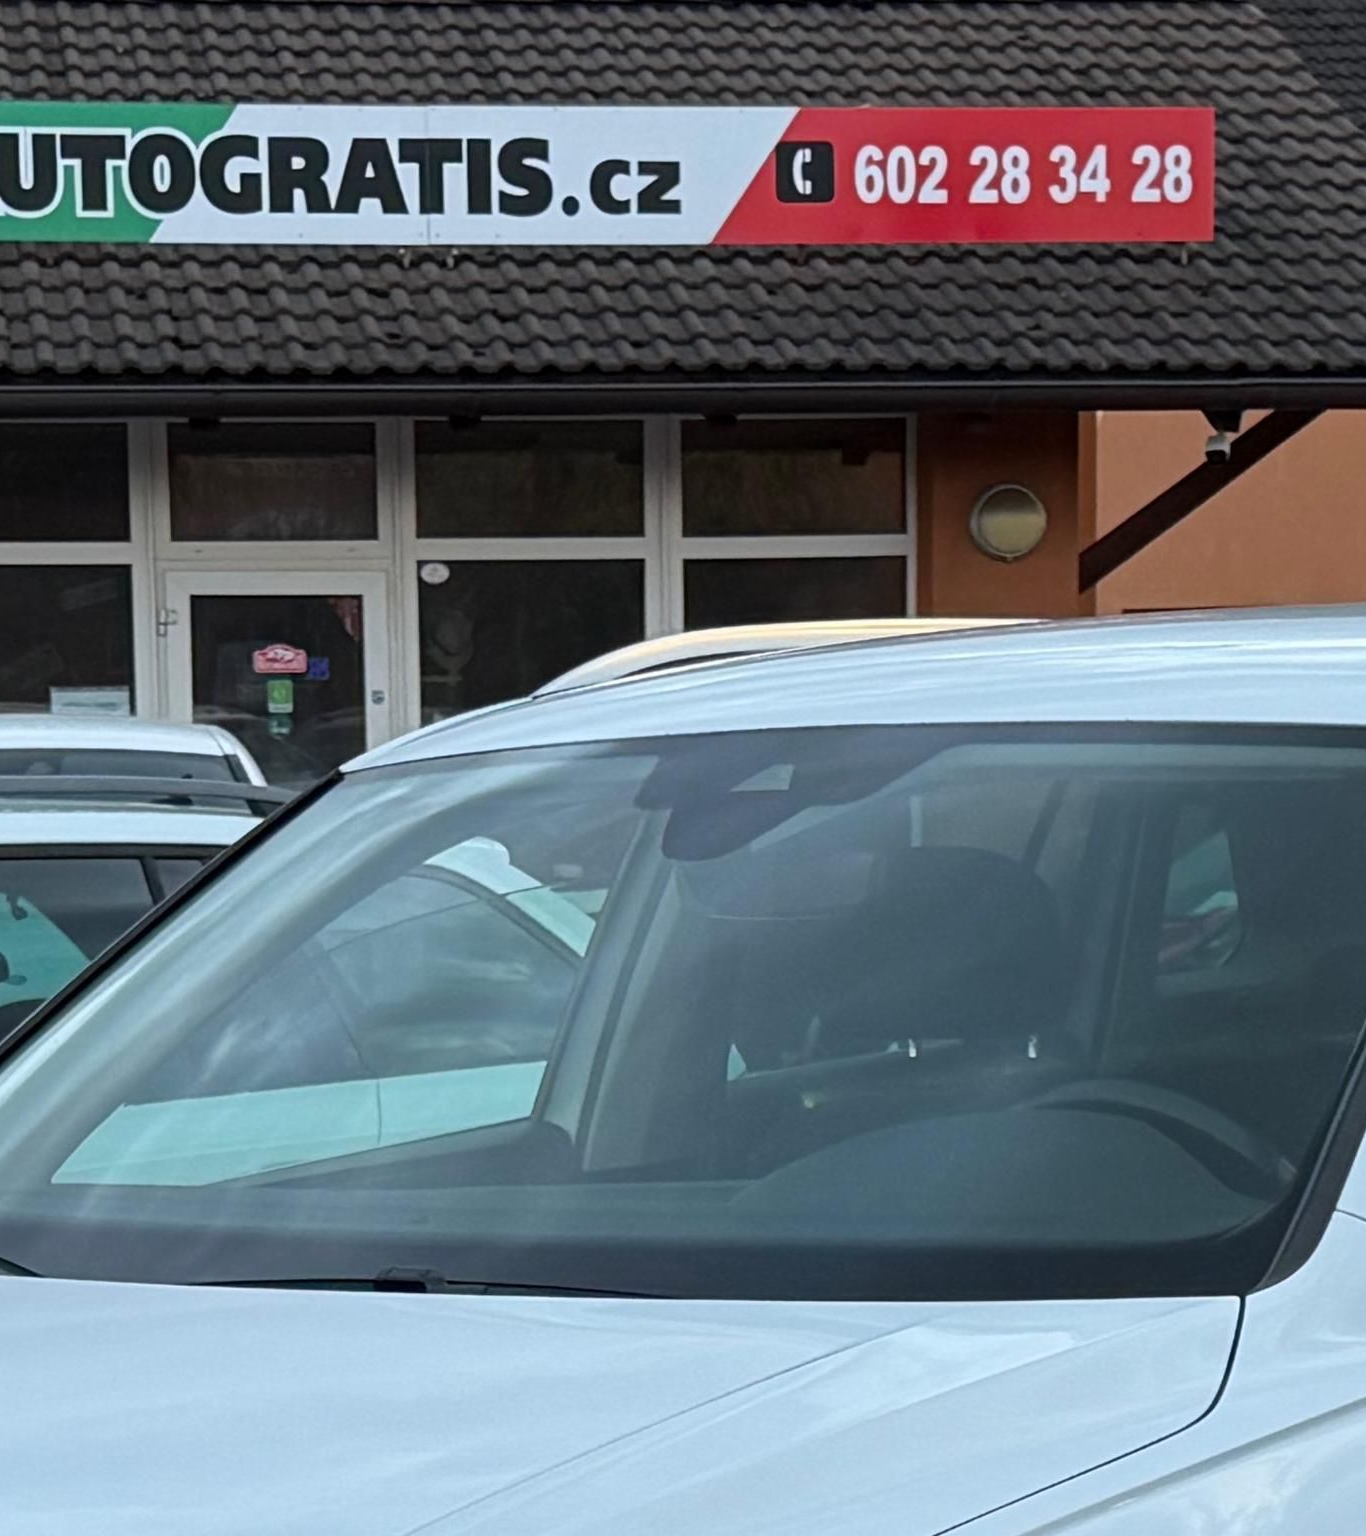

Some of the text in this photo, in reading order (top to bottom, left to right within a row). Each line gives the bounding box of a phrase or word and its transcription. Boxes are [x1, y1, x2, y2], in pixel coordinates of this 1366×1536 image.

[854, 143, 949, 205] 602
[969, 144, 1032, 205] 28
[1047, 144, 1111, 205] 34
[1131, 144, 1194, 205] 28
